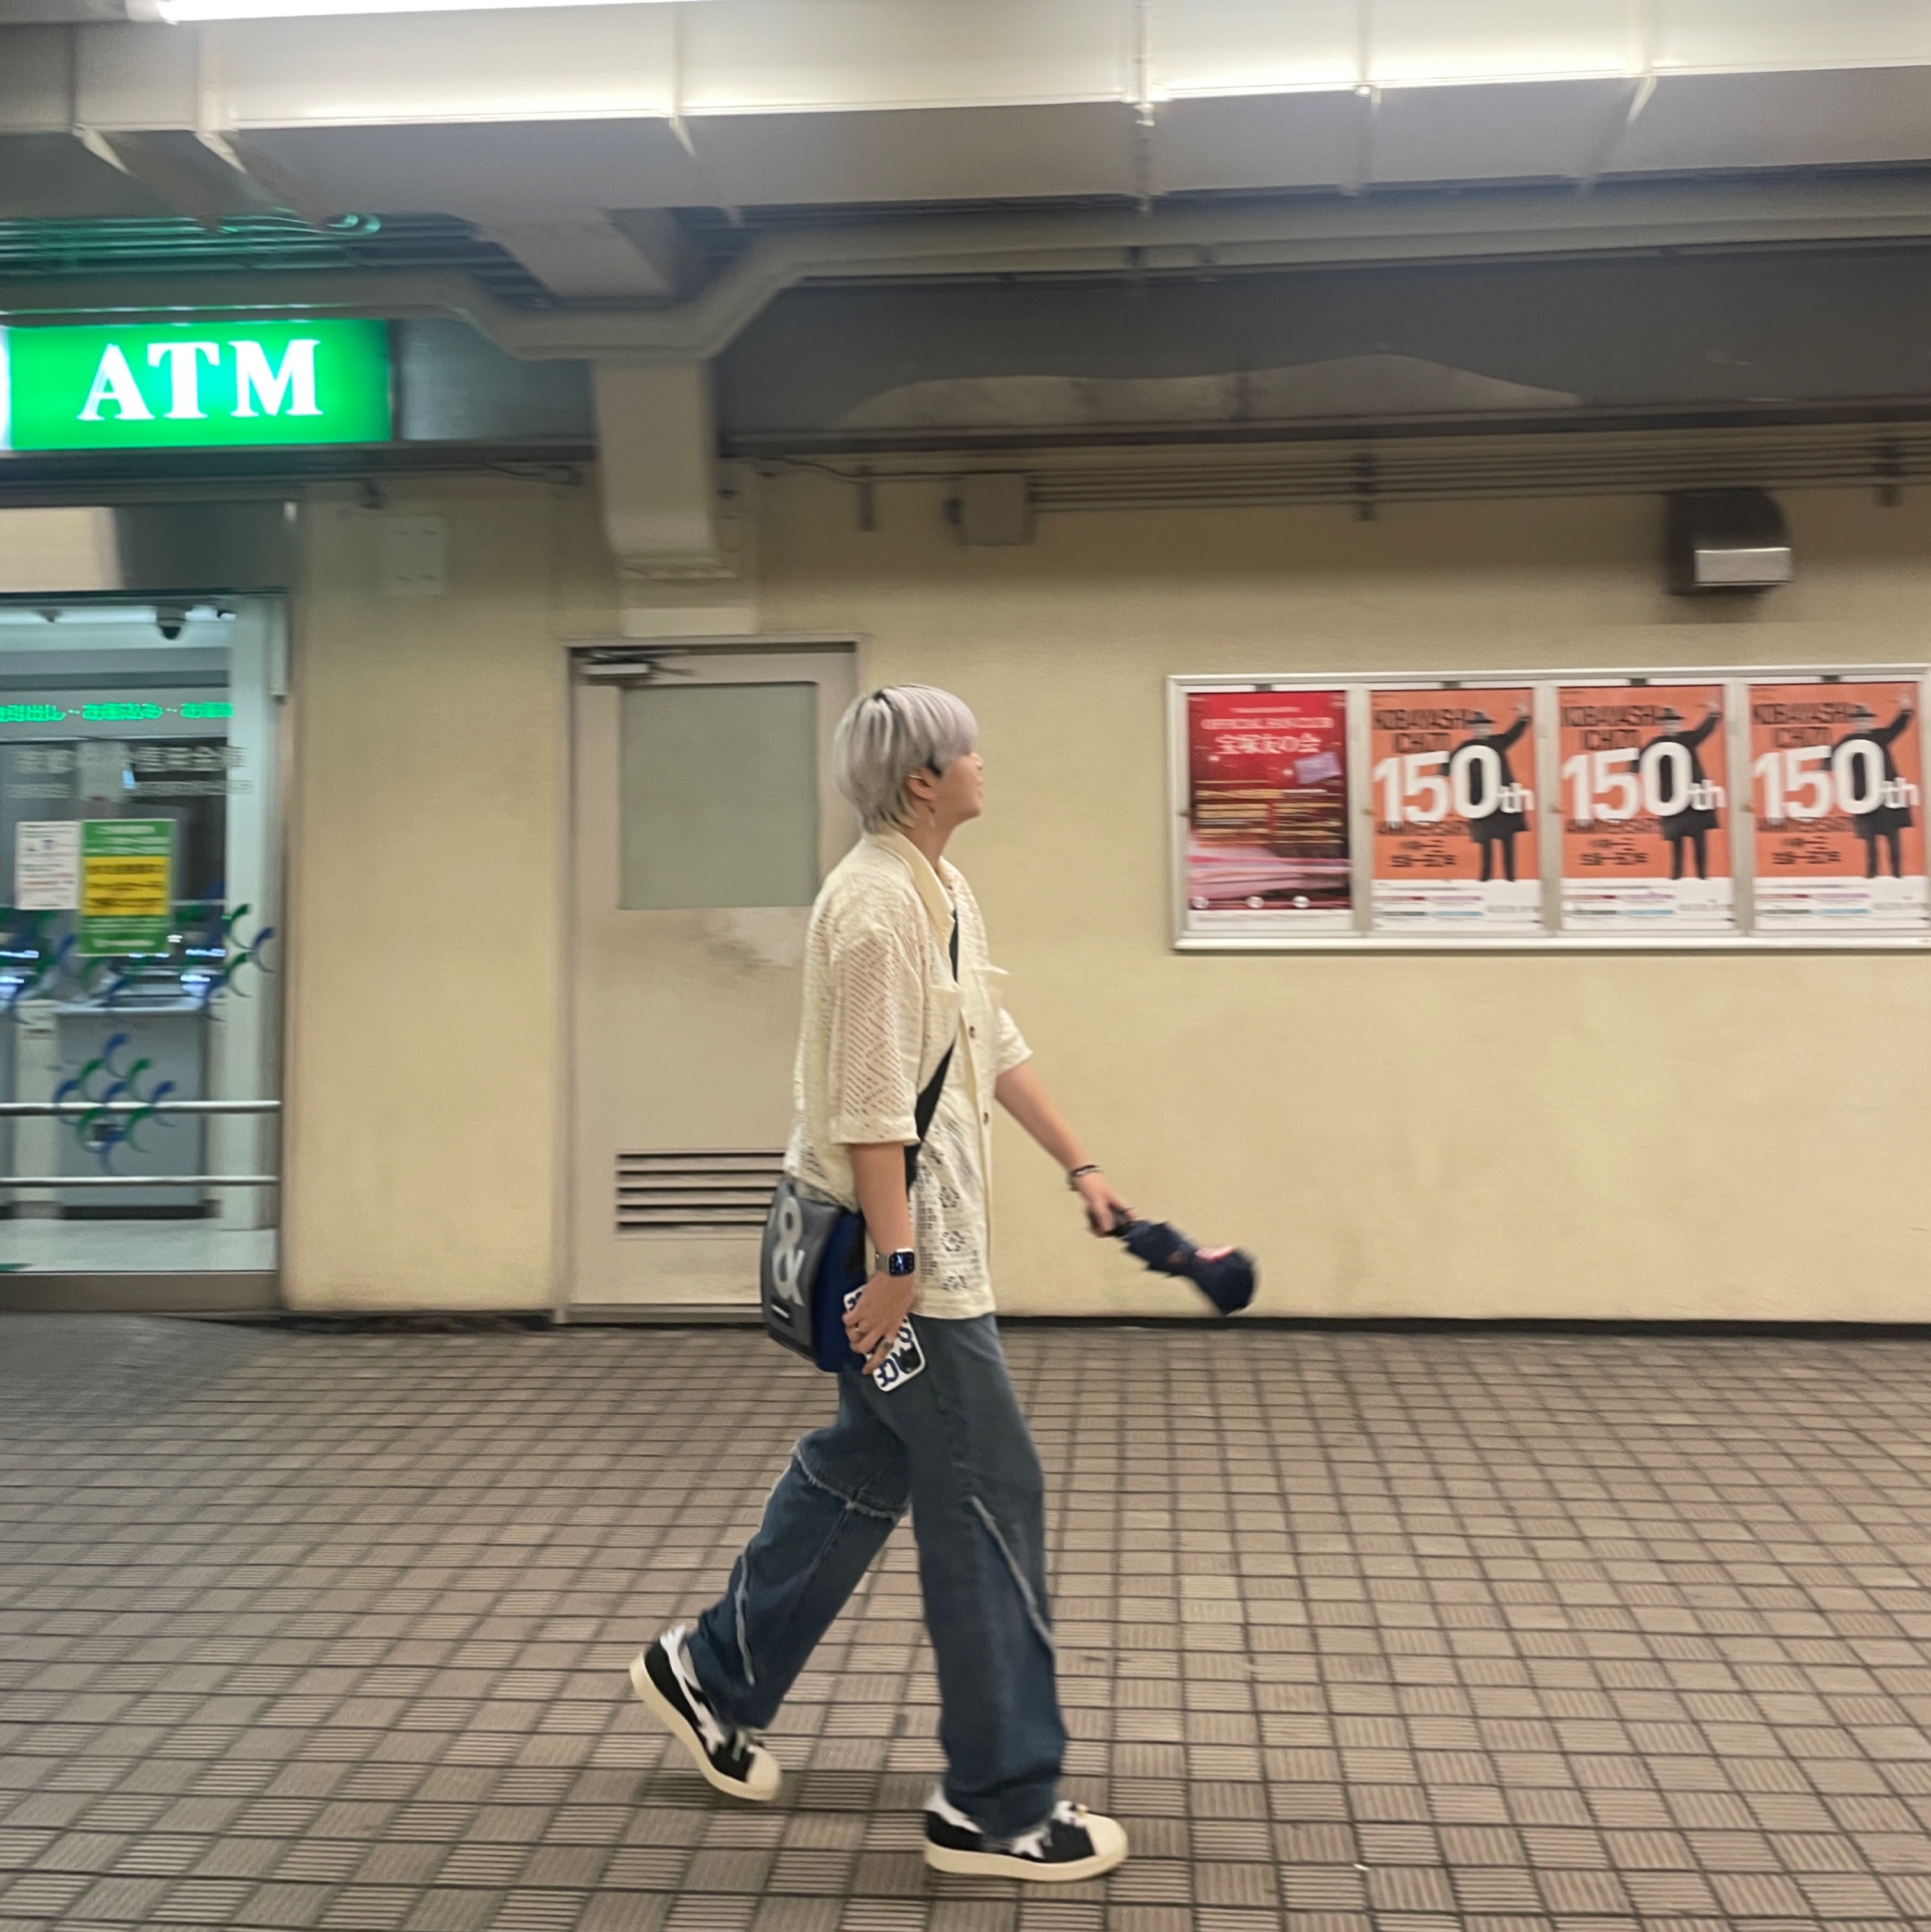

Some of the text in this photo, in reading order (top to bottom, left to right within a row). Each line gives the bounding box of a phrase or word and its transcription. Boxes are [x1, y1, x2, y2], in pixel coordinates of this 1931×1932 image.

[77, 339, 323, 420] ATM
[1373, 744, 1535, 829] 150th
[1562, 742, 1727, 826] 150th
[1754, 739, 1919, 825] 150th
